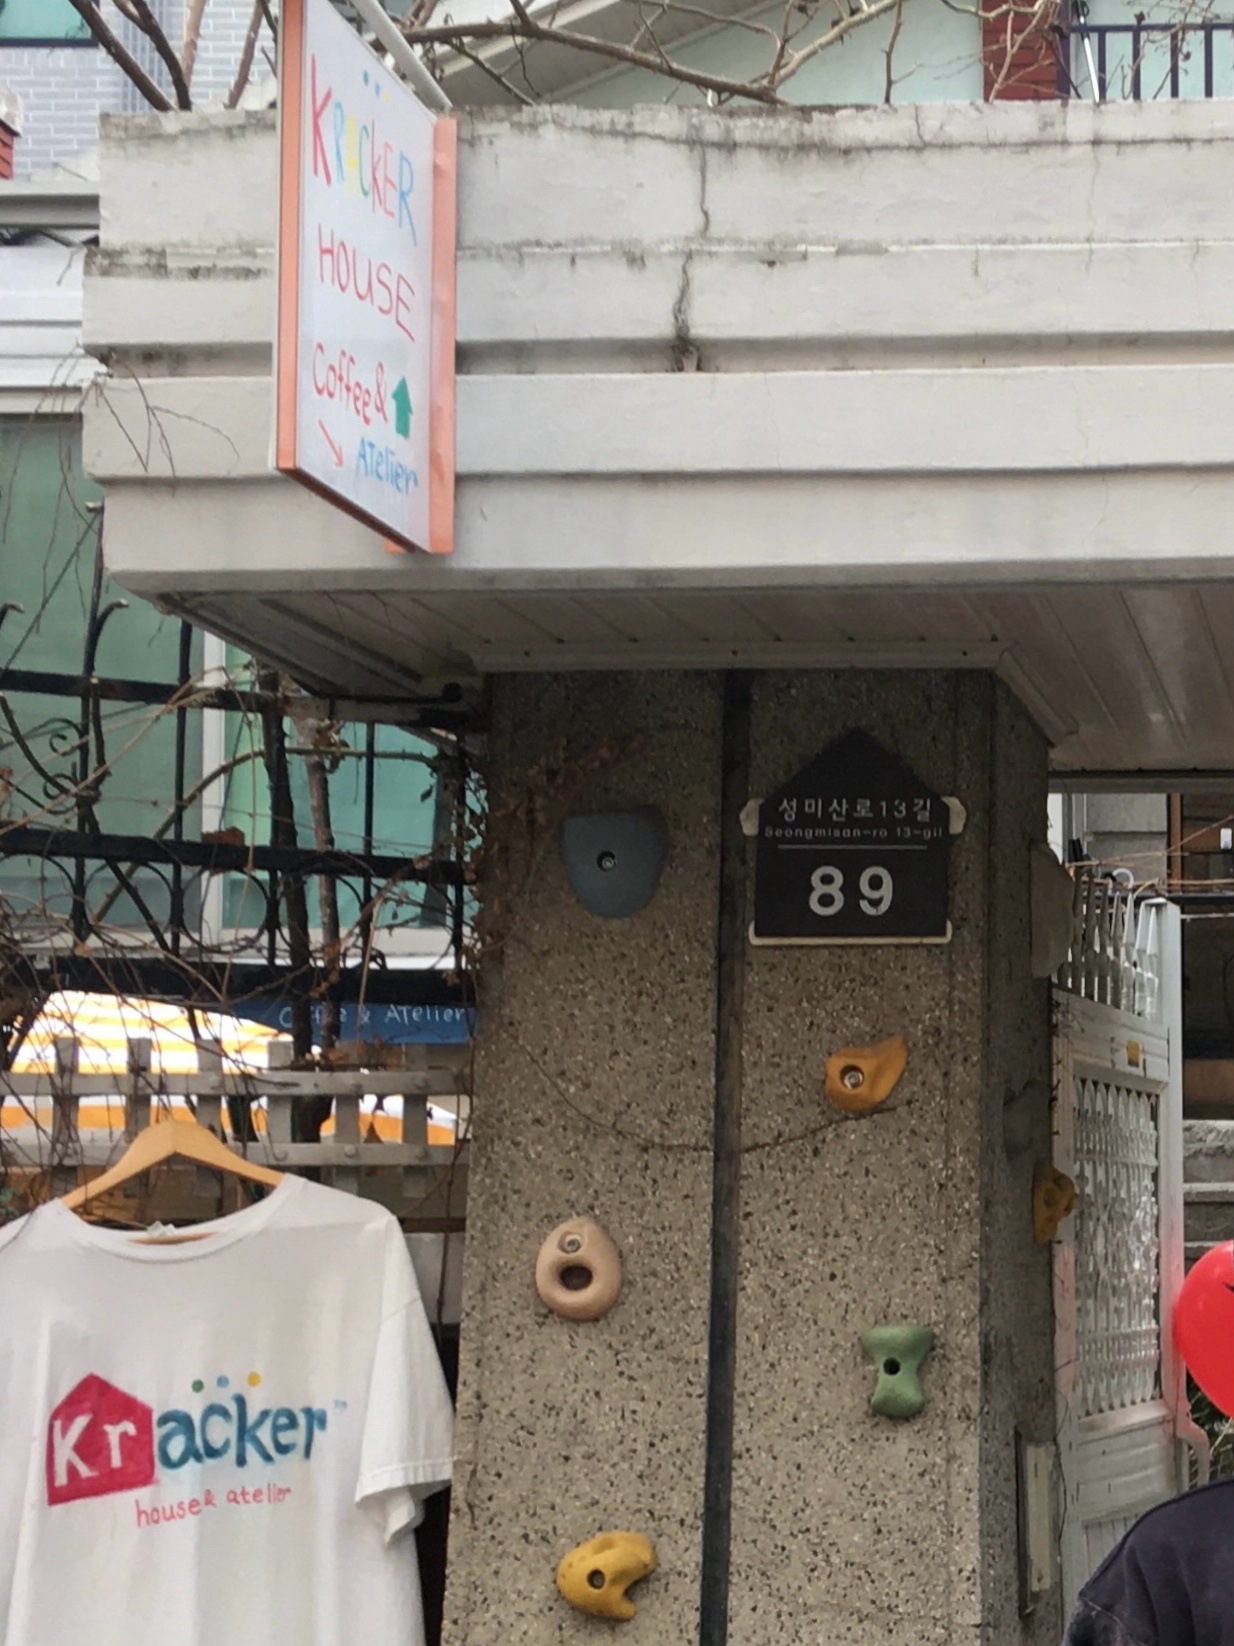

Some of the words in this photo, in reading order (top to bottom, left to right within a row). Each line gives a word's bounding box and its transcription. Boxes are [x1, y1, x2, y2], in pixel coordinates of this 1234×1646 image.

[317, 224, 415, 342] HOUSE
[764, 826, 888, 840] Seongmisan-ro
[896, 826, 943, 840] 13-gil
[808, 865, 894, 917] 89
[51, 1392, 327, 1487] Kracker
